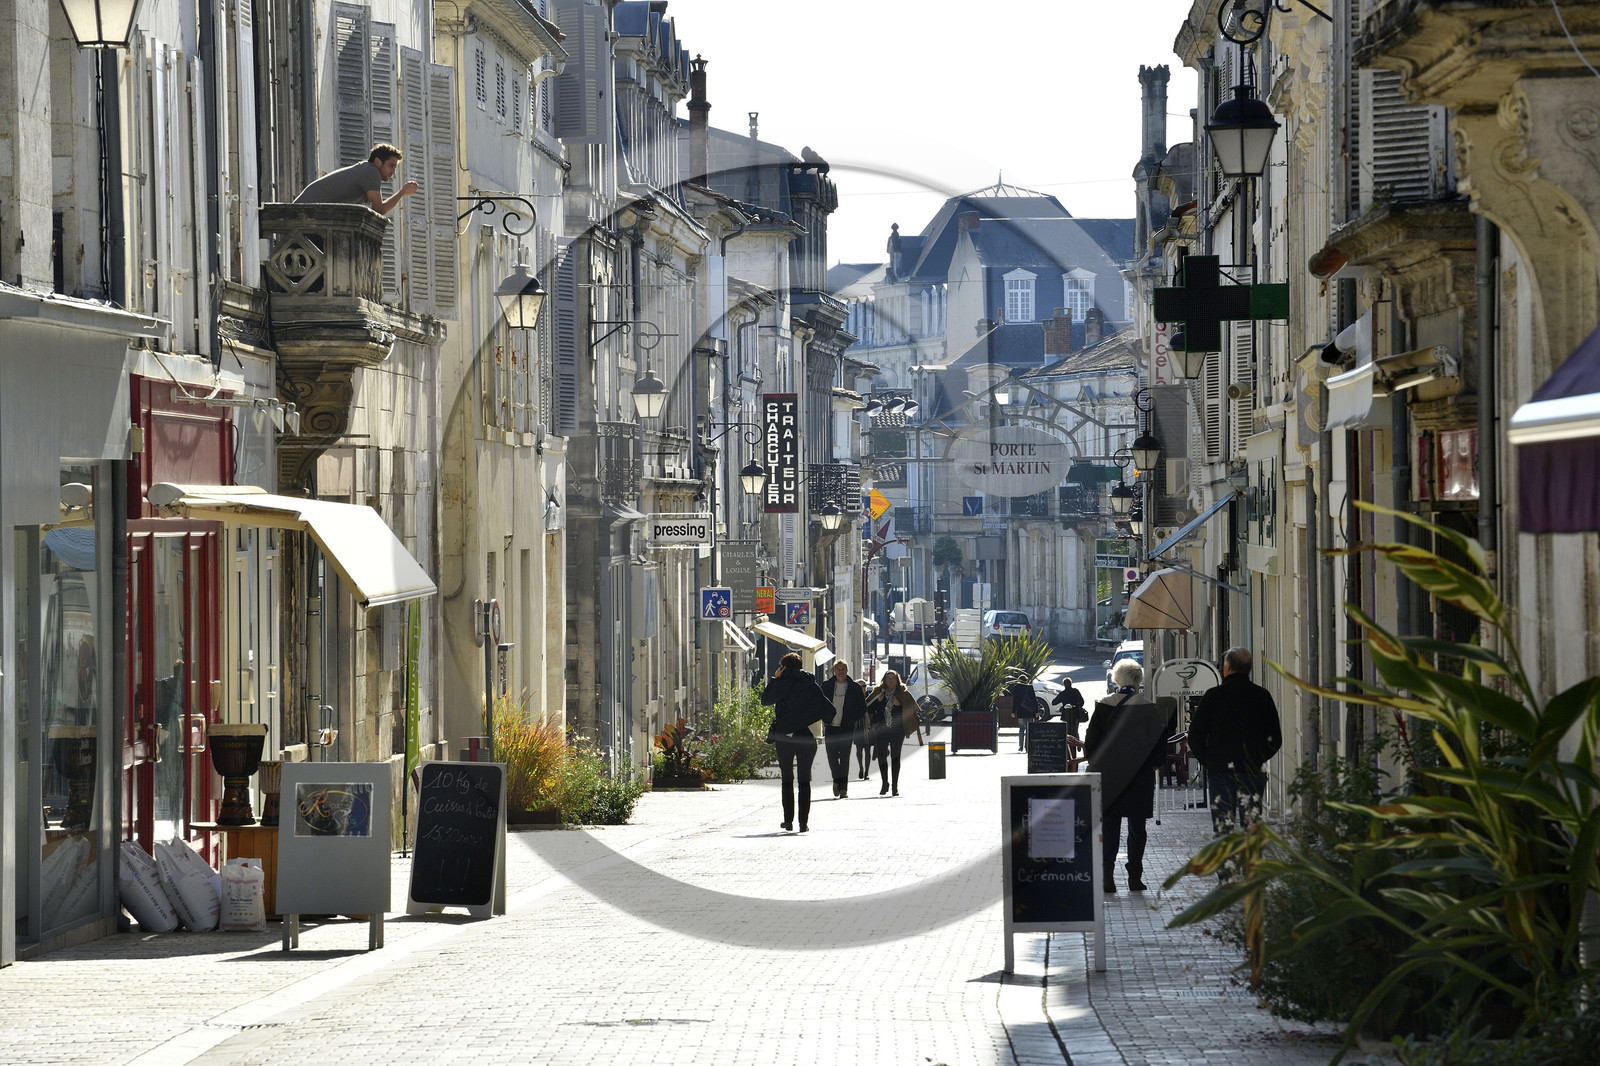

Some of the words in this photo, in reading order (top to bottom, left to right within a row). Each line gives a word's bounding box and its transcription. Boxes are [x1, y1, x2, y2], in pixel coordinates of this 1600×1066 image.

[766, 402, 780, 504] CHARCUTIER
[782, 402, 795, 504] TRAITEUR
[990, 443, 1037, 456] PORTE
[974, 462, 987, 475] St
[992, 462, 1051, 475] MARTIN
[654, 523, 706, 539] pressing
[756, 589, 773, 598] NERAL
[424, 771, 453, 789] 10
[456, 771, 470, 794] Kg
[475, 777, 488, 792] de
[1017, 868, 1091, 882] Cérémonies
